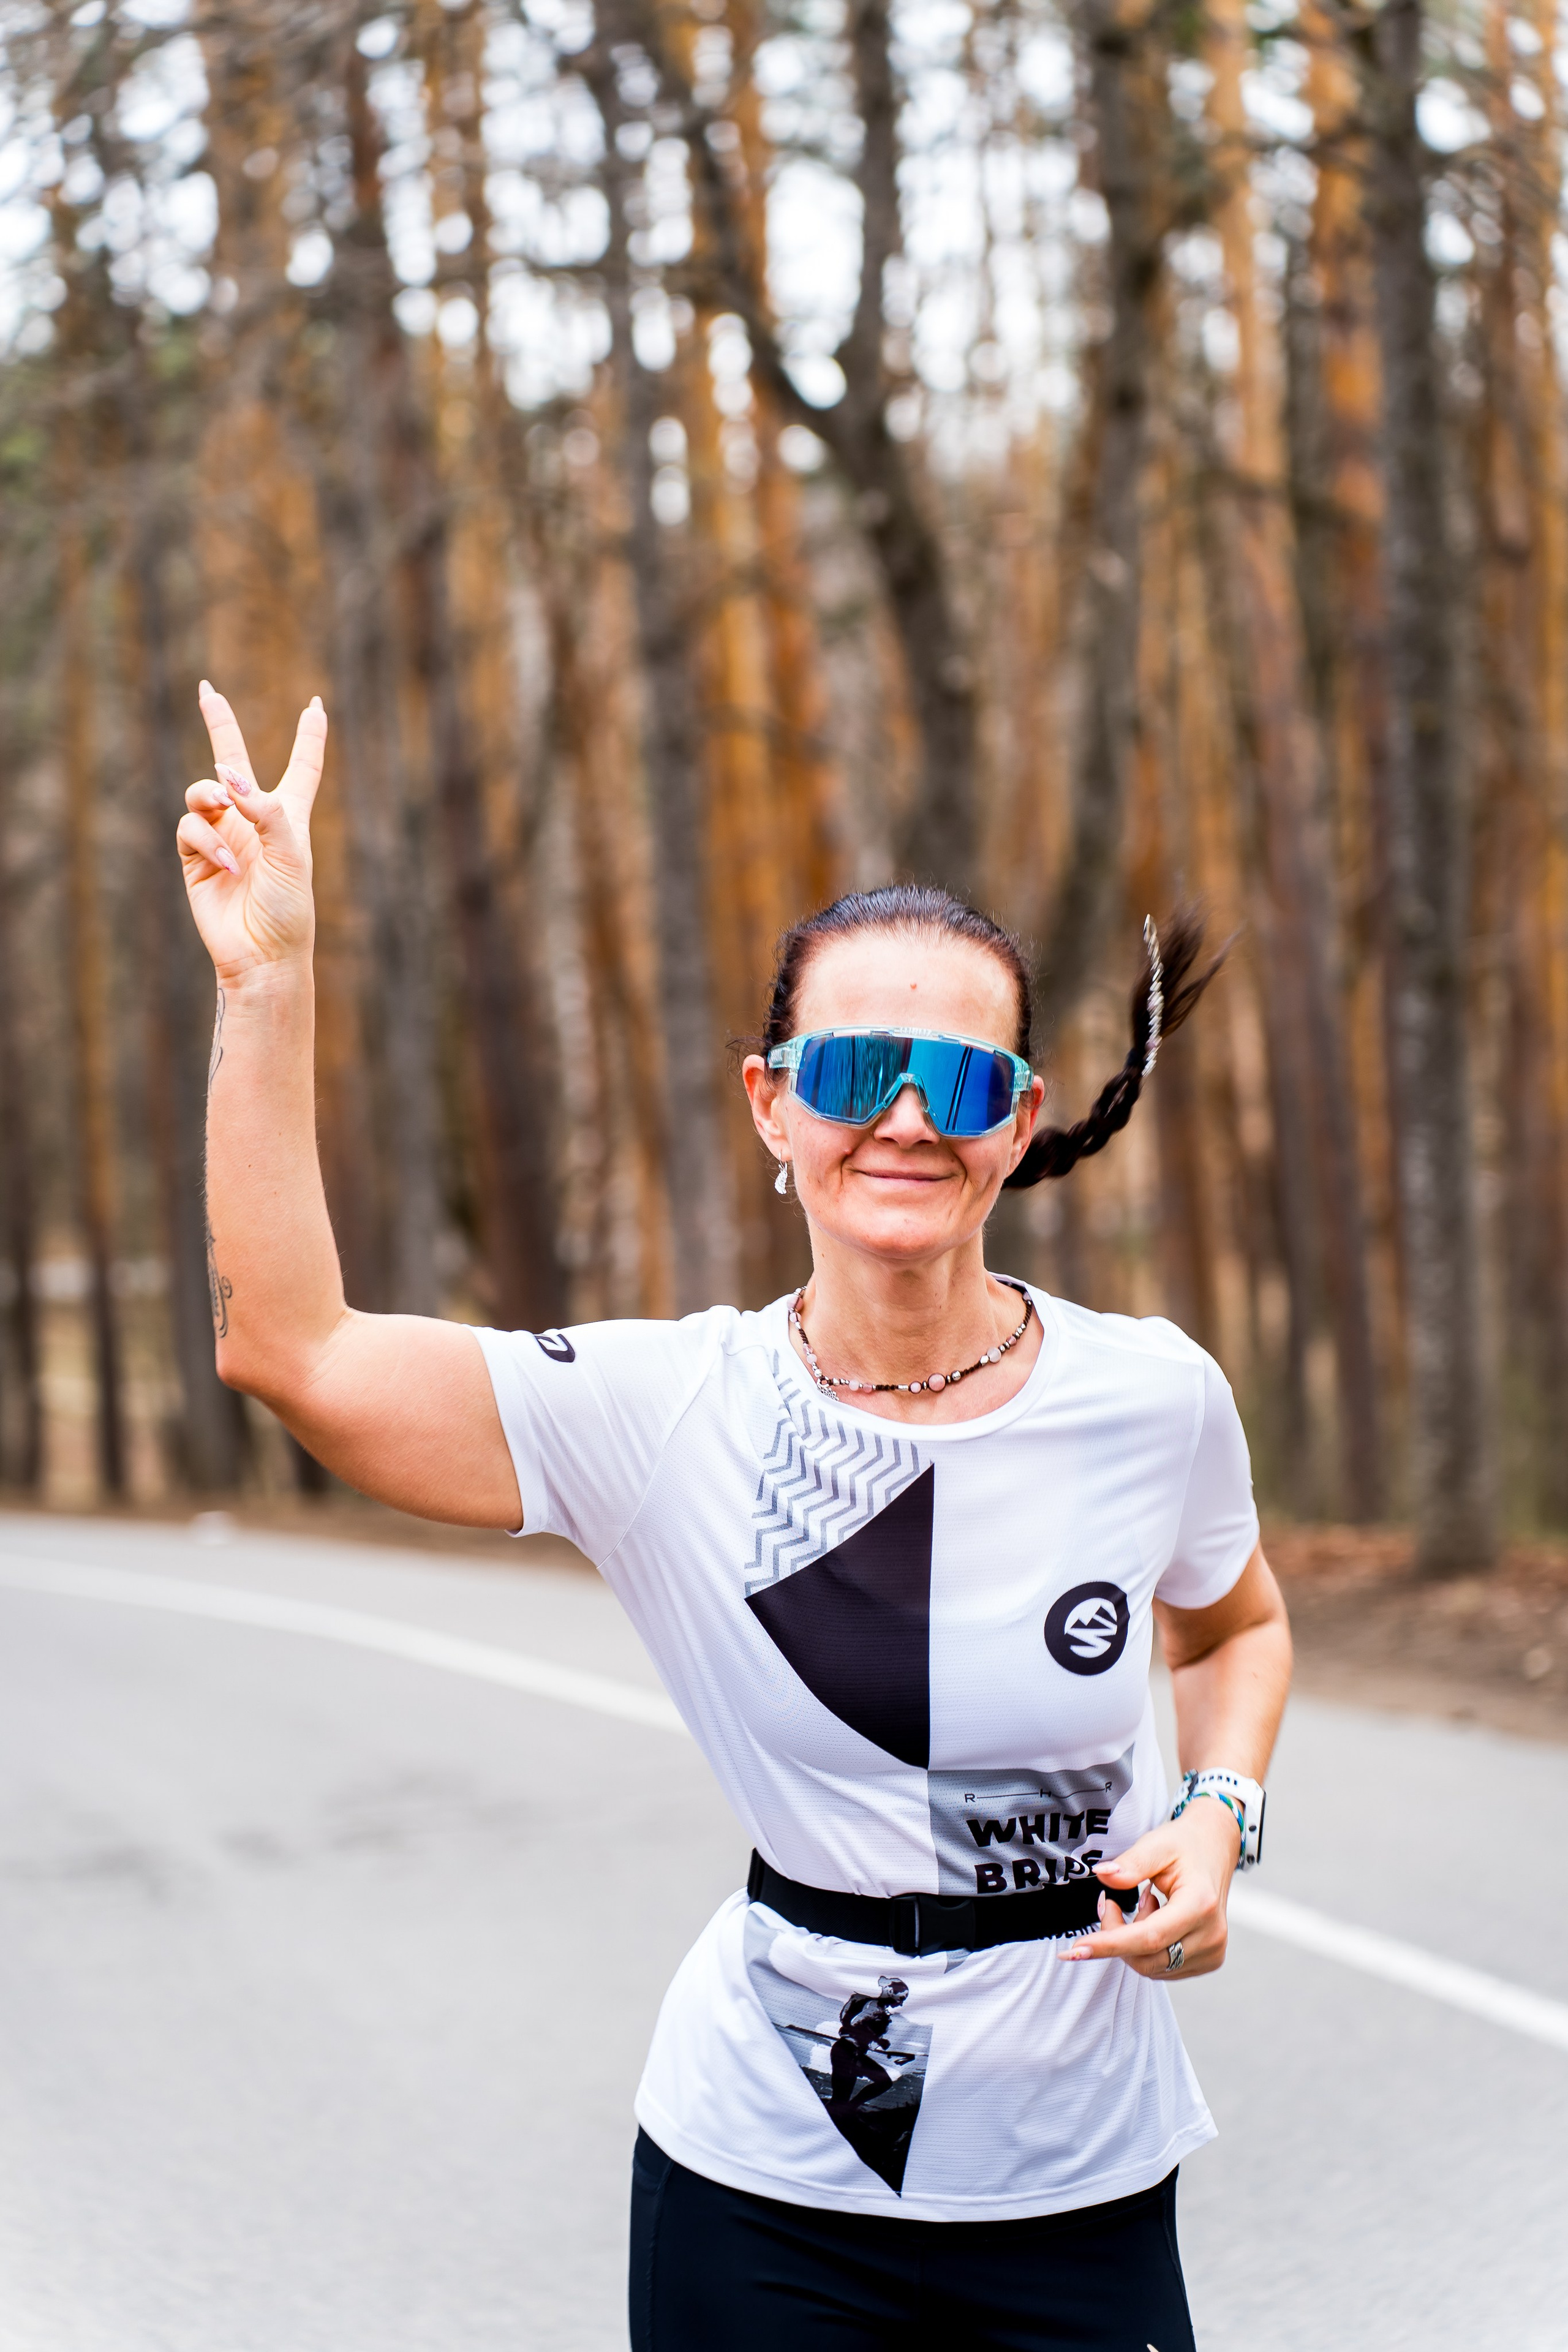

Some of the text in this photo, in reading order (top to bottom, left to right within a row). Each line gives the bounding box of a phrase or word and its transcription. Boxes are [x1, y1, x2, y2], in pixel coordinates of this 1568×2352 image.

[964, 1793, 976, 1803] R
[1105, 1782, 1112, 1793] R
[966, 1809, 1112, 1847] WHITE
